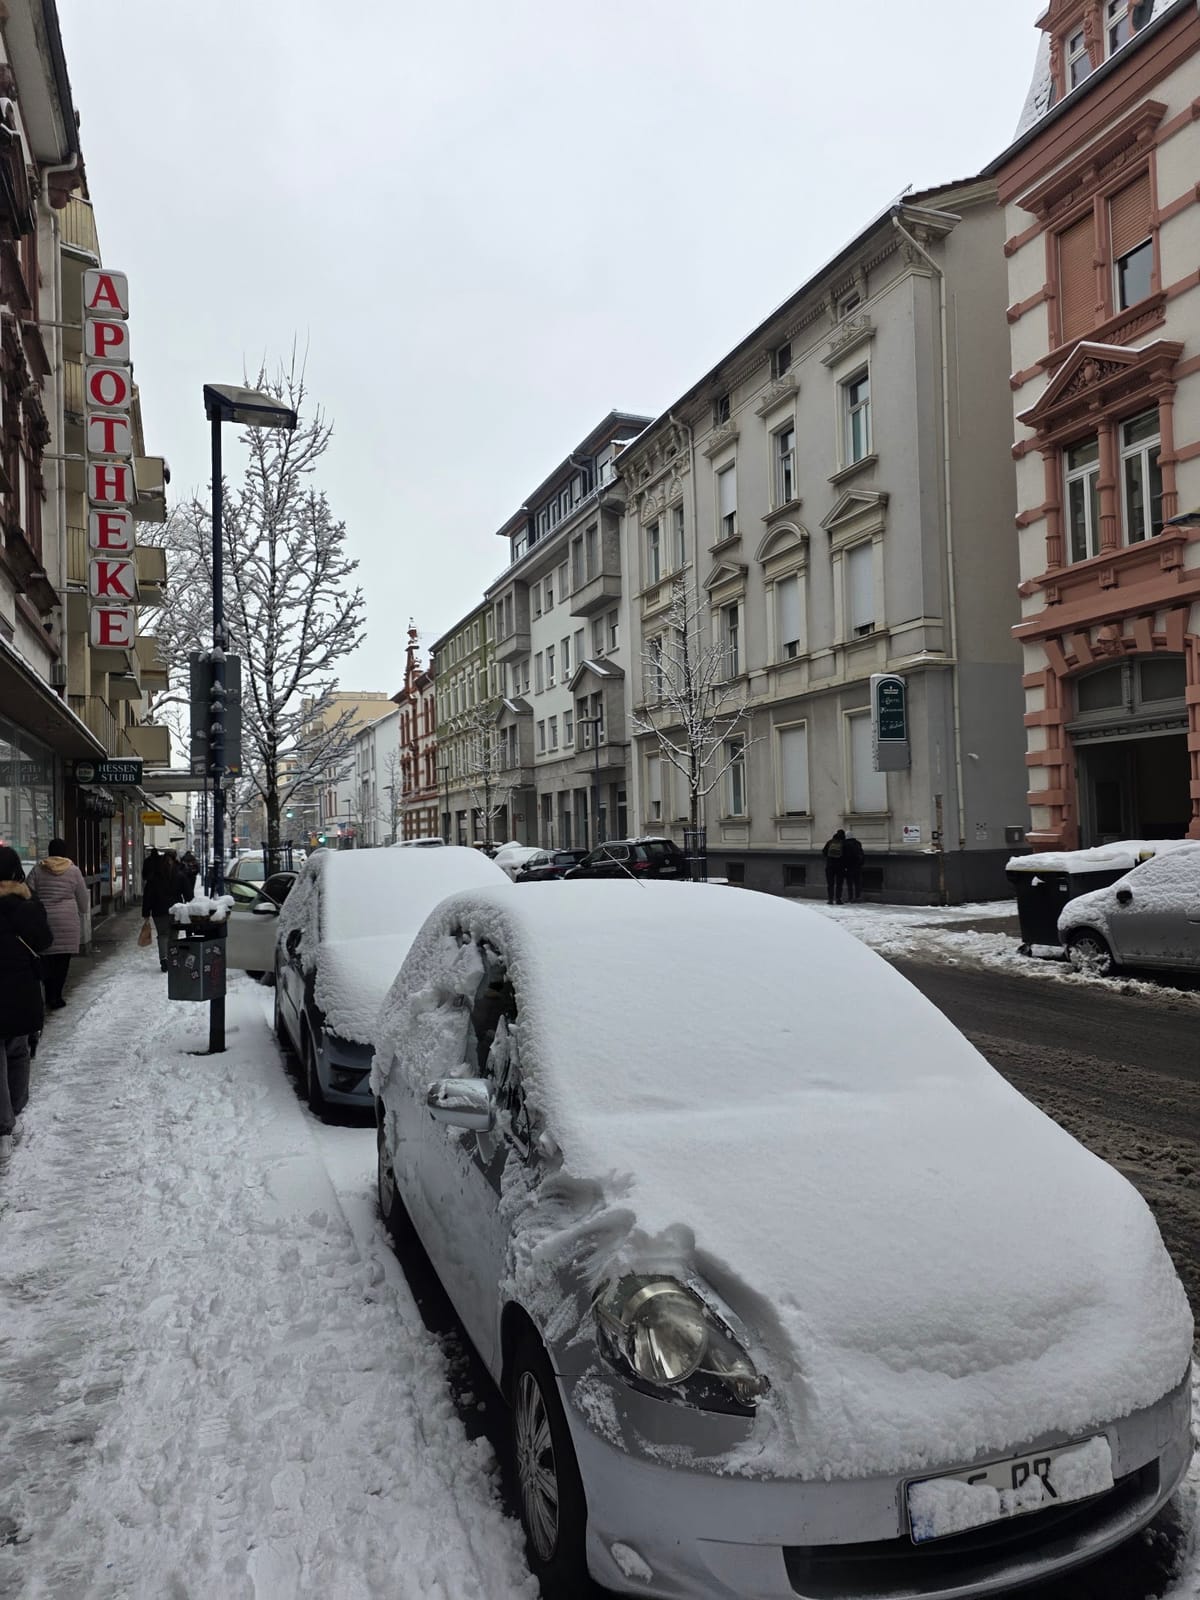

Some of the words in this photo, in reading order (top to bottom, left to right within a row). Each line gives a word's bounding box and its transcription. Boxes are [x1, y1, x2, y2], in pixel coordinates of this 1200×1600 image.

[88, 275, 131, 646] APOTHEKE
[98, 763, 138, 773] HESSEN
[101, 773, 135, 782] STUBB
